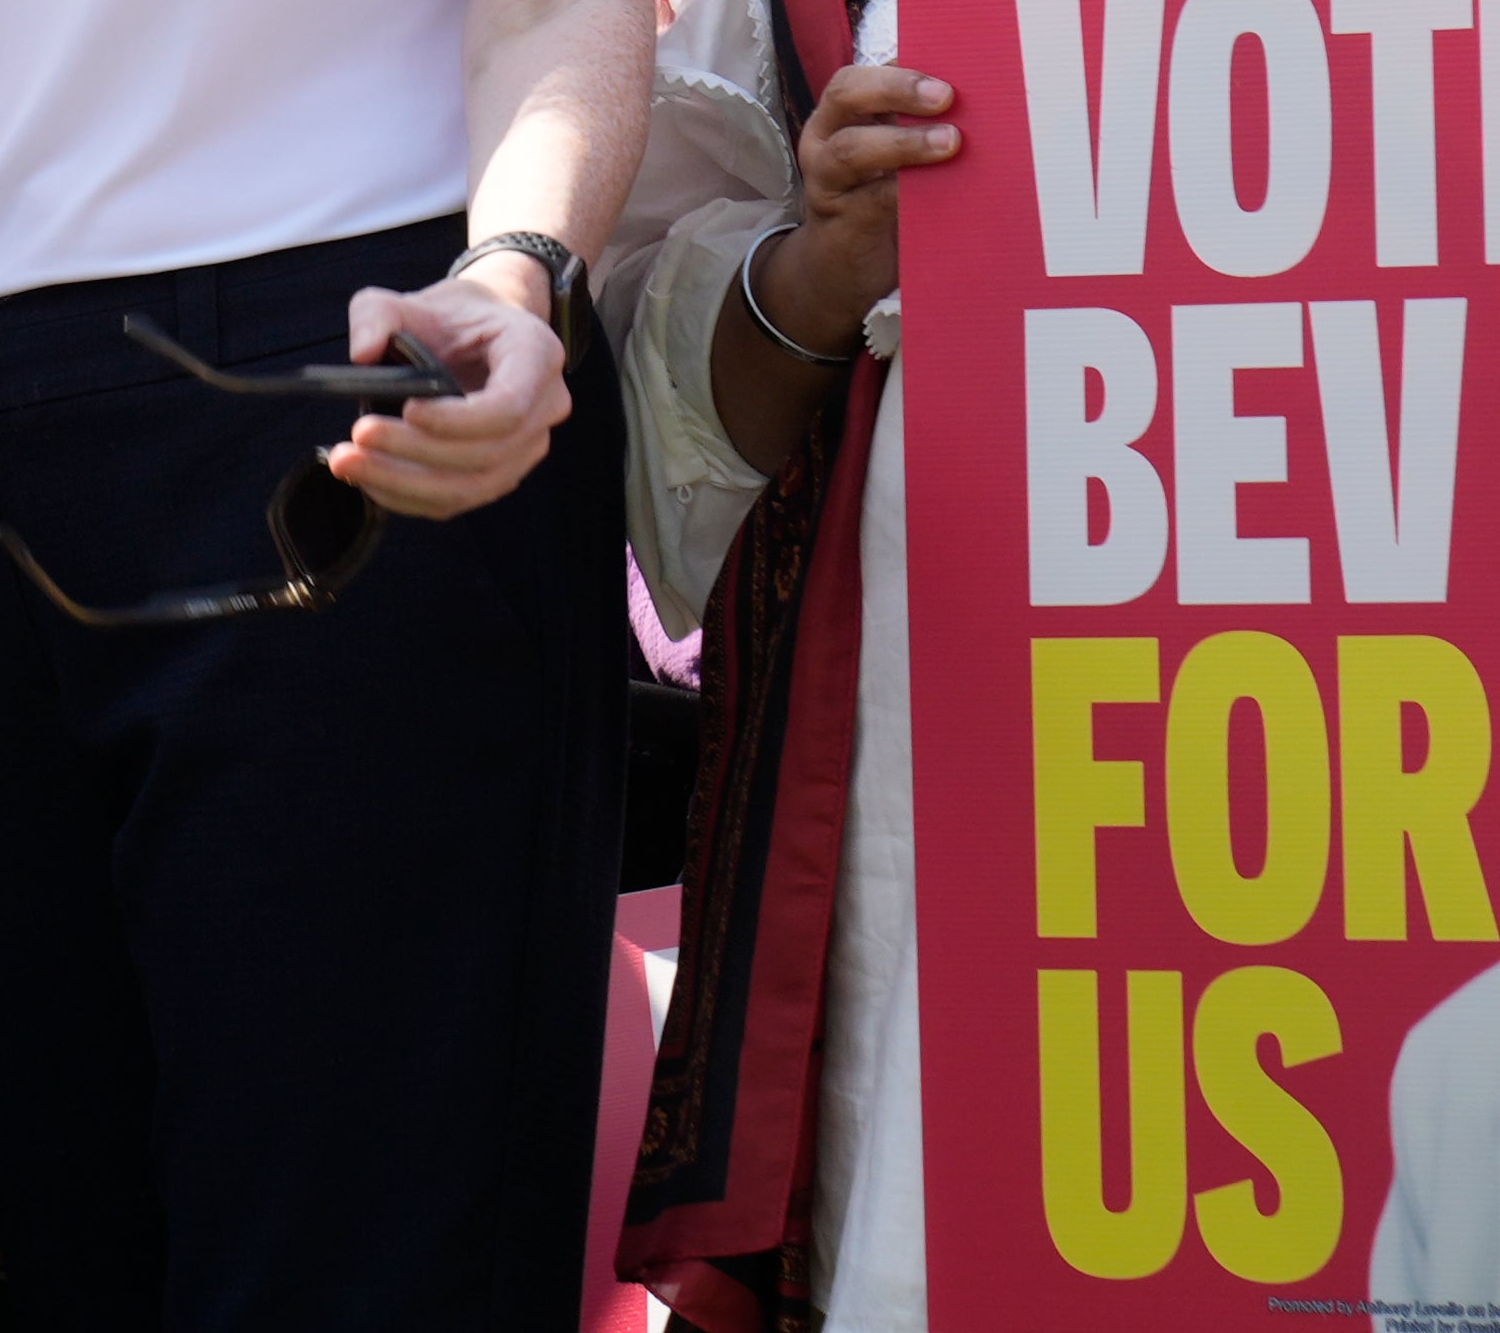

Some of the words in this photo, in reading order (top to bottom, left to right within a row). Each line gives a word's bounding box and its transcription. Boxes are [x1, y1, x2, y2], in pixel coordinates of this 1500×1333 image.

[1024, 297, 1468, 606] BEV
[1030, 630, 1500, 946] FOR
[1037, 965, 1344, 1284] US
[1268, 1297, 1335, 1315] Promoted
[1336, 1301, 1353, 1316] by
[1355, 1299, 1414, 1317] Anthony
[1466, 1303, 1486, 1317] on
